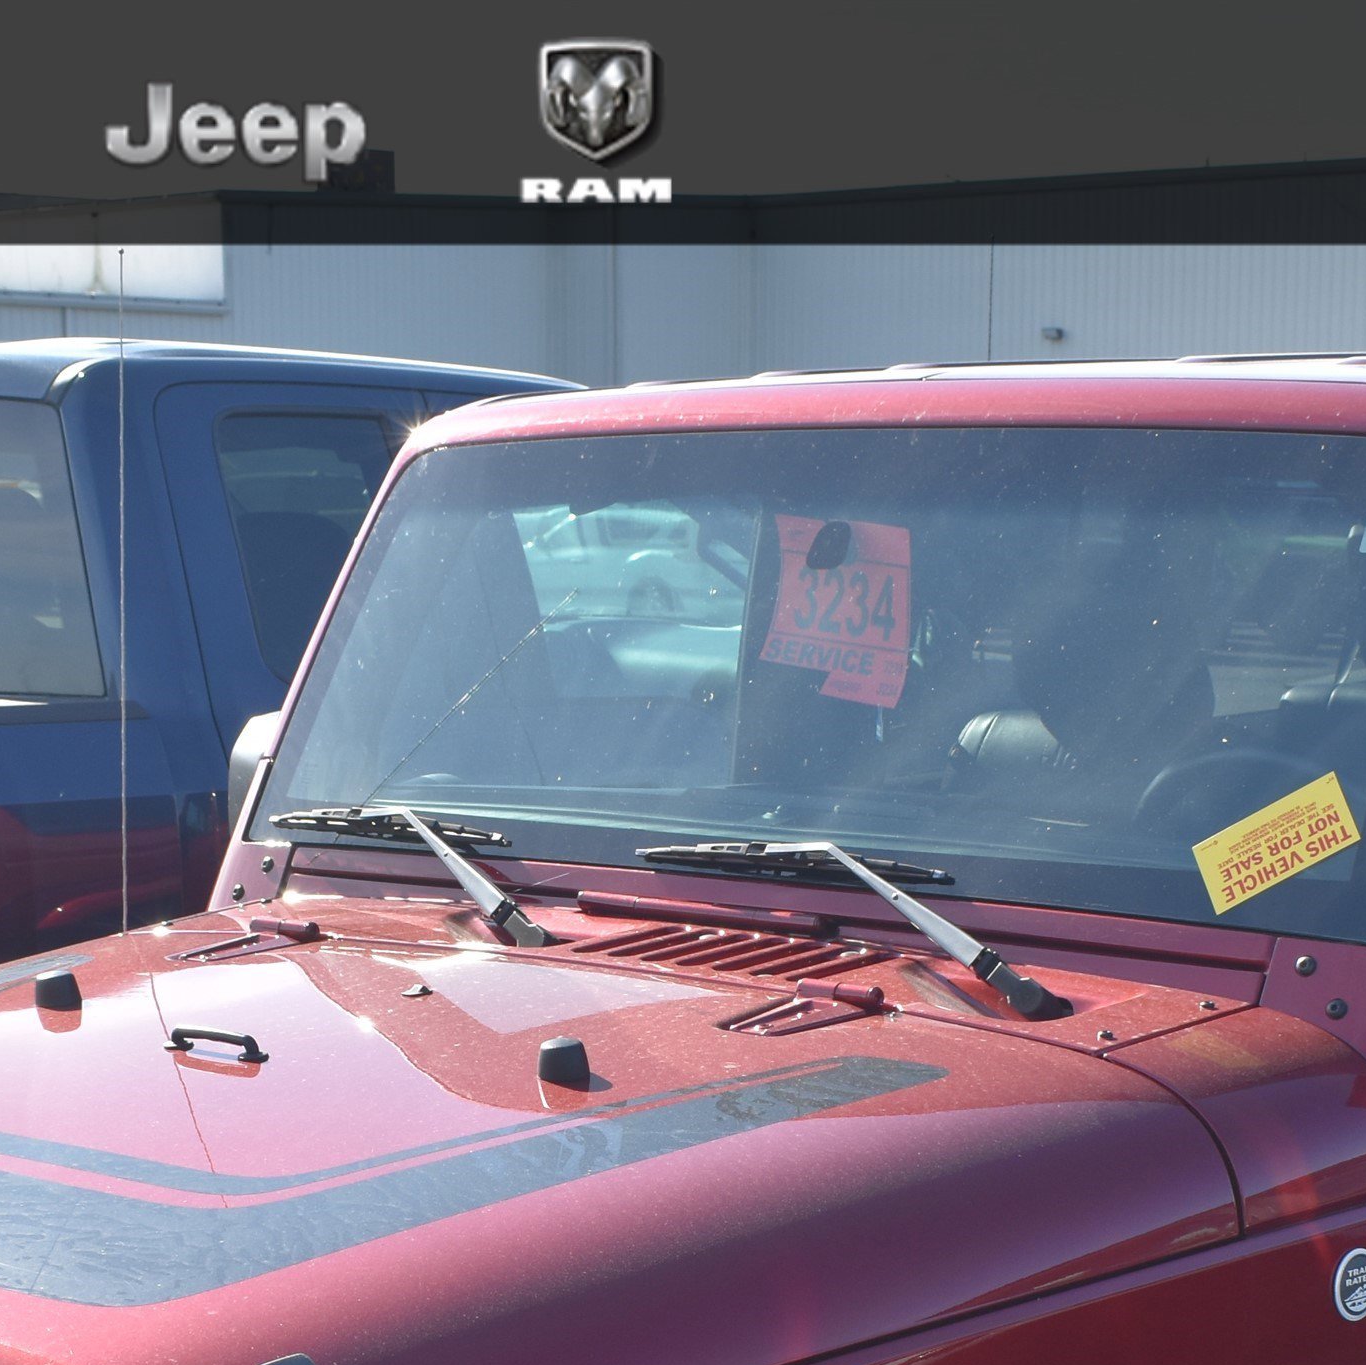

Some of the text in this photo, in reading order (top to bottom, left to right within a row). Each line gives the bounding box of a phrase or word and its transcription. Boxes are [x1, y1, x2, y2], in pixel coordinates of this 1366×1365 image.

[794, 566, 896, 643] 3234
[765, 638, 875, 676] SERVICE
[1279, 818, 1306, 836] DEALER
[1307, 811, 1320, 822] THE
[1307, 810, 1341, 838] NOT
[1236, 841, 1262, 859] RESALE
[1263, 833, 1278, 844] FOR
[1266, 830, 1303, 857] FOR
[1305, 825, 1353, 858] THIS
[1217, 856, 1235, 870] DATE
[1220, 851, 1264, 883] SALE
[1221, 850, 1305, 904] VEHICLE
